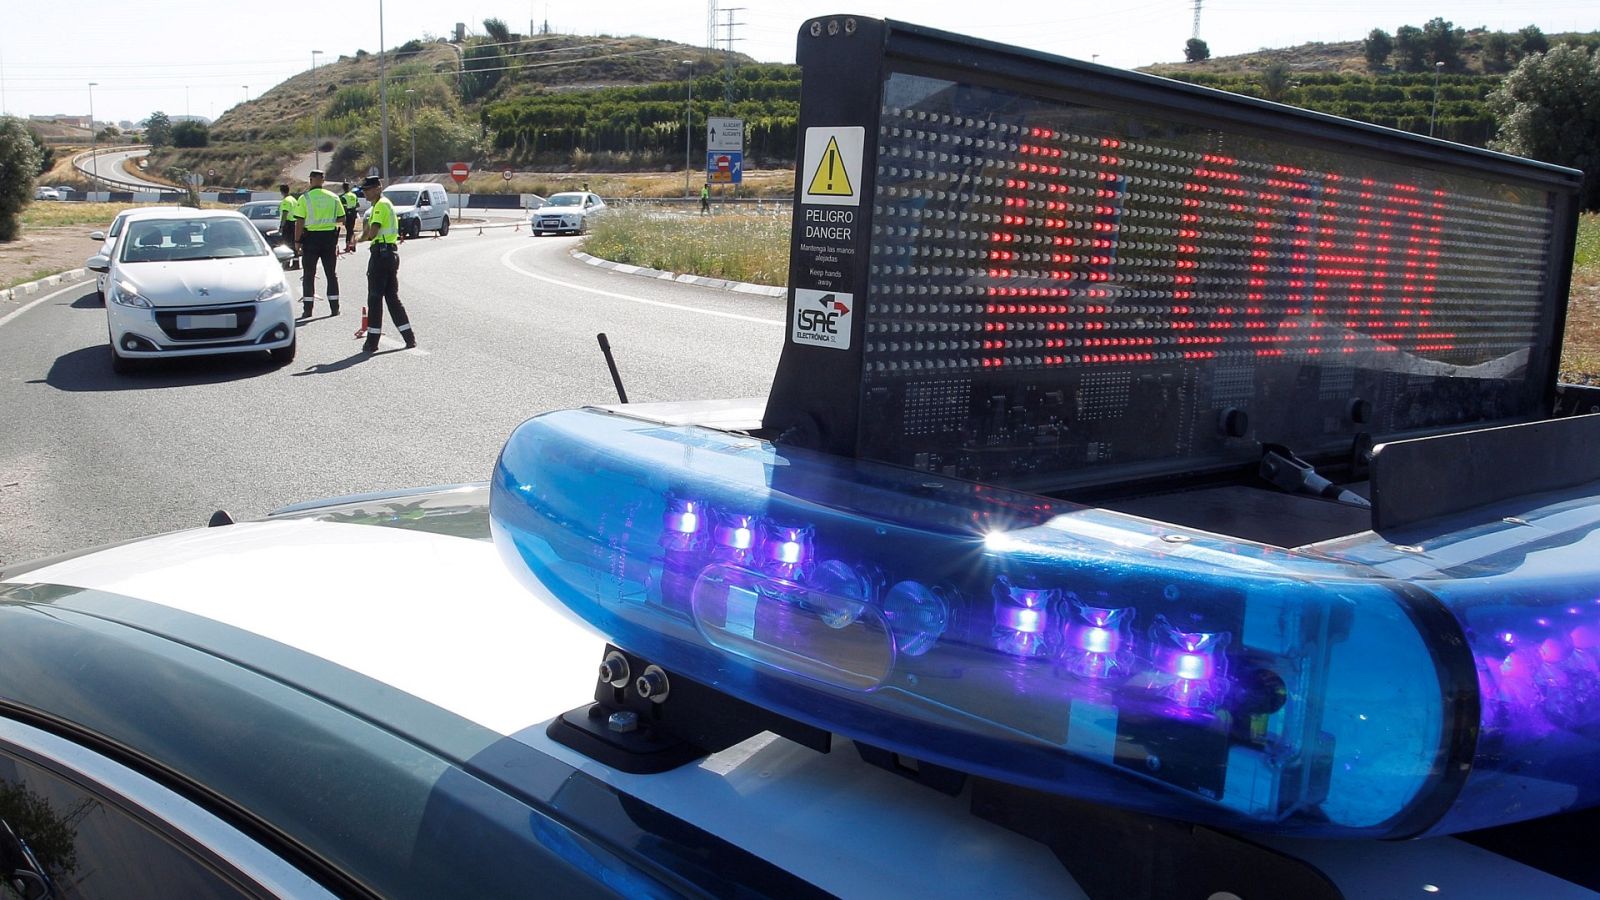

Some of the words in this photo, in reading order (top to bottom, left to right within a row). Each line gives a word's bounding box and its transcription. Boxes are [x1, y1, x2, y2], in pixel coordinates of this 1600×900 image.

[805, 209, 854, 223] PELIGRO
[805, 226, 851, 240] DANGER
[800, 243, 826, 254] Mantenga
[827, 245, 836, 253] las
[836, 247, 855, 255] manos
[982, 127, 1457, 367] ALCOHOL
[815, 254, 838, 263] alejadas
[809, 268, 824, 277] Keep
[825, 269, 842, 278] hands
[817, 279, 833, 287] away
[796, 331, 830, 342] ELECTRÓNICA
